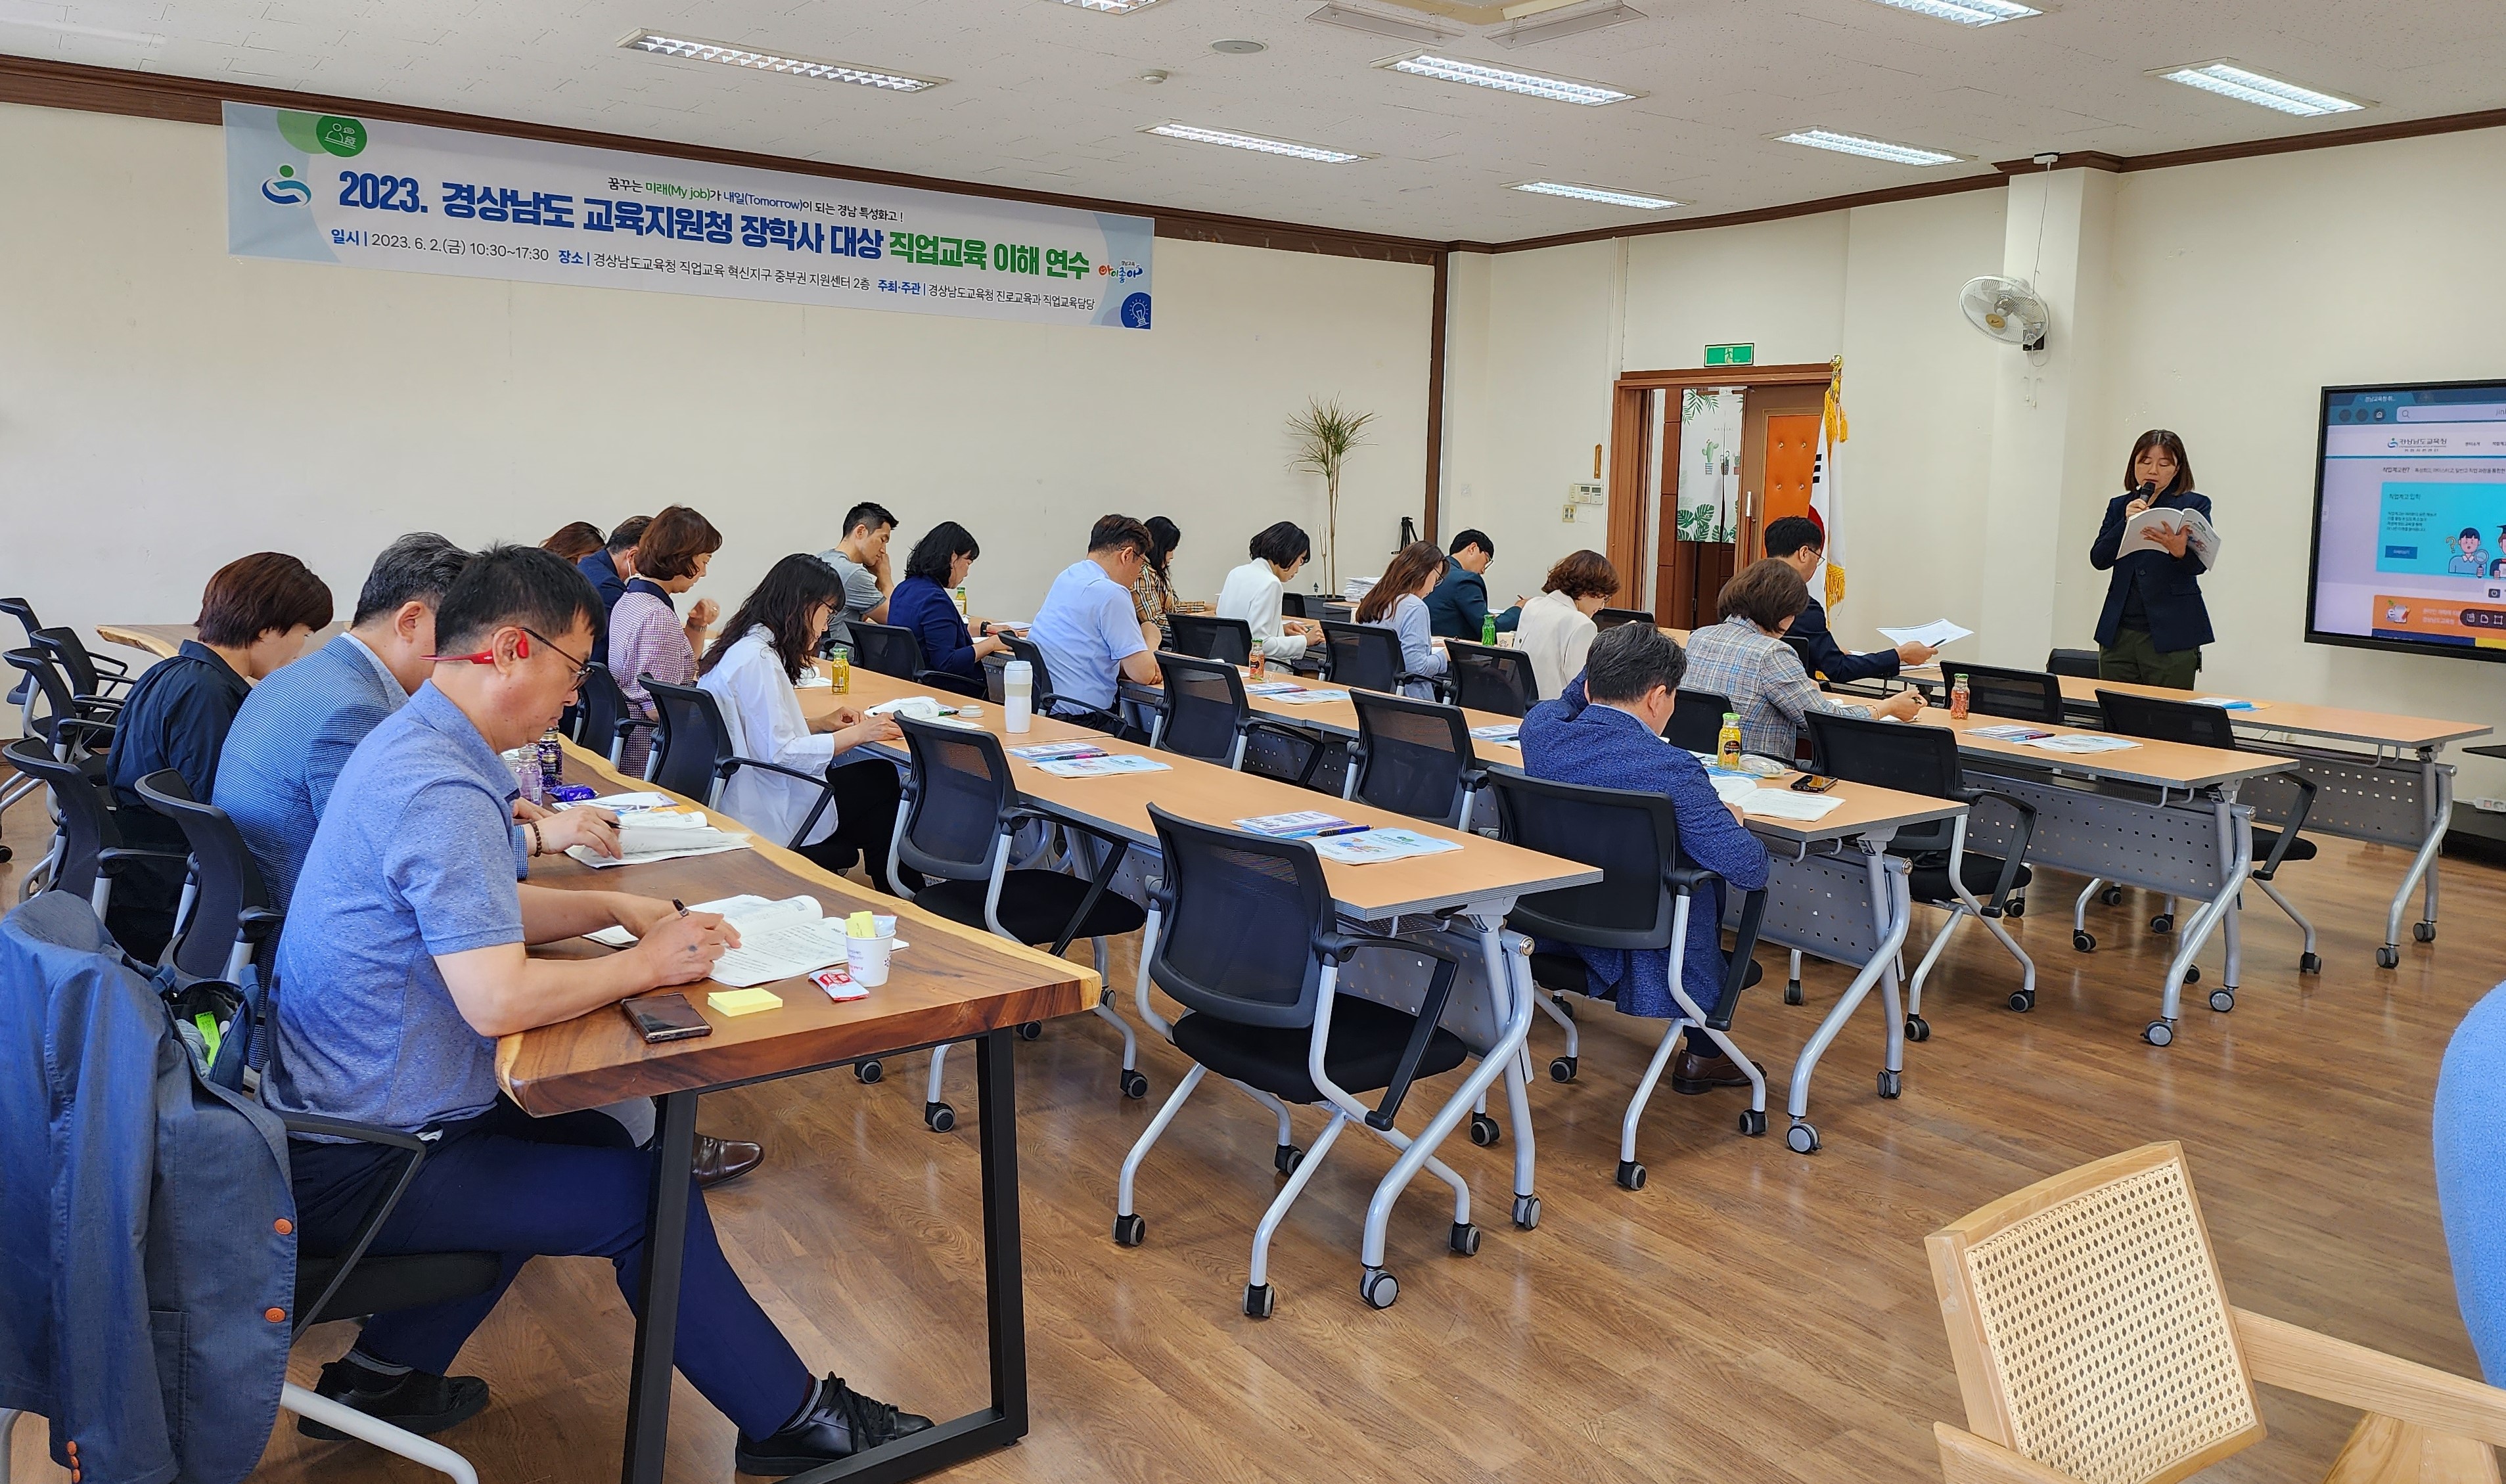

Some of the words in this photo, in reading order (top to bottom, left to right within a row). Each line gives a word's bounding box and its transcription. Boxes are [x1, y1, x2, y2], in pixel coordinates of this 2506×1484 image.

[608, 177, 643, 192] 꿈꾸는
[645, 183, 687, 199] 미래(My
[689, 187, 721, 201] job)가
[723, 191, 812, 212] 내일(Tomorrow)이
[815, 202, 835, 215] 되는
[838, 205, 857, 217] 경남
[859, 207, 898, 221] 특성화고
[331, 229, 359, 246] 일시
[371, 233, 411, 249] 2023.
[415, 238, 426, 250] 6.
[430, 238, 467, 256] 2.(금)
[470, 242, 549, 261] 10:30~17:30
[339, 170, 428, 214] 2023.
[442, 181, 575, 229] 경상남도
[583, 197, 733, 243] 교육지원청
[740, 214, 825, 254] 장학사
[830, 224, 884, 259] 대상
[889, 231, 988, 271] 직업교육
[993, 242, 1040, 276] 이해
[1045, 248, 1090, 280] 연수
[558, 250, 584, 265] 장소
[593, 252, 676, 273] 경상남도교육청
[679, 259, 725, 277] 직업교육
[727, 265, 773, 282] 혁신지구
[774, 269, 807, 284] 중부권
[809, 273, 851, 290] 지원센터
[853, 277, 871, 290] 2층
[877, 279, 921, 295] 주최·주관
[928, 283, 994, 302] 경상남도교육청
[996, 289, 1041, 306] 진로교육과
[1043, 294, 1095, 311] 직업교육담당
